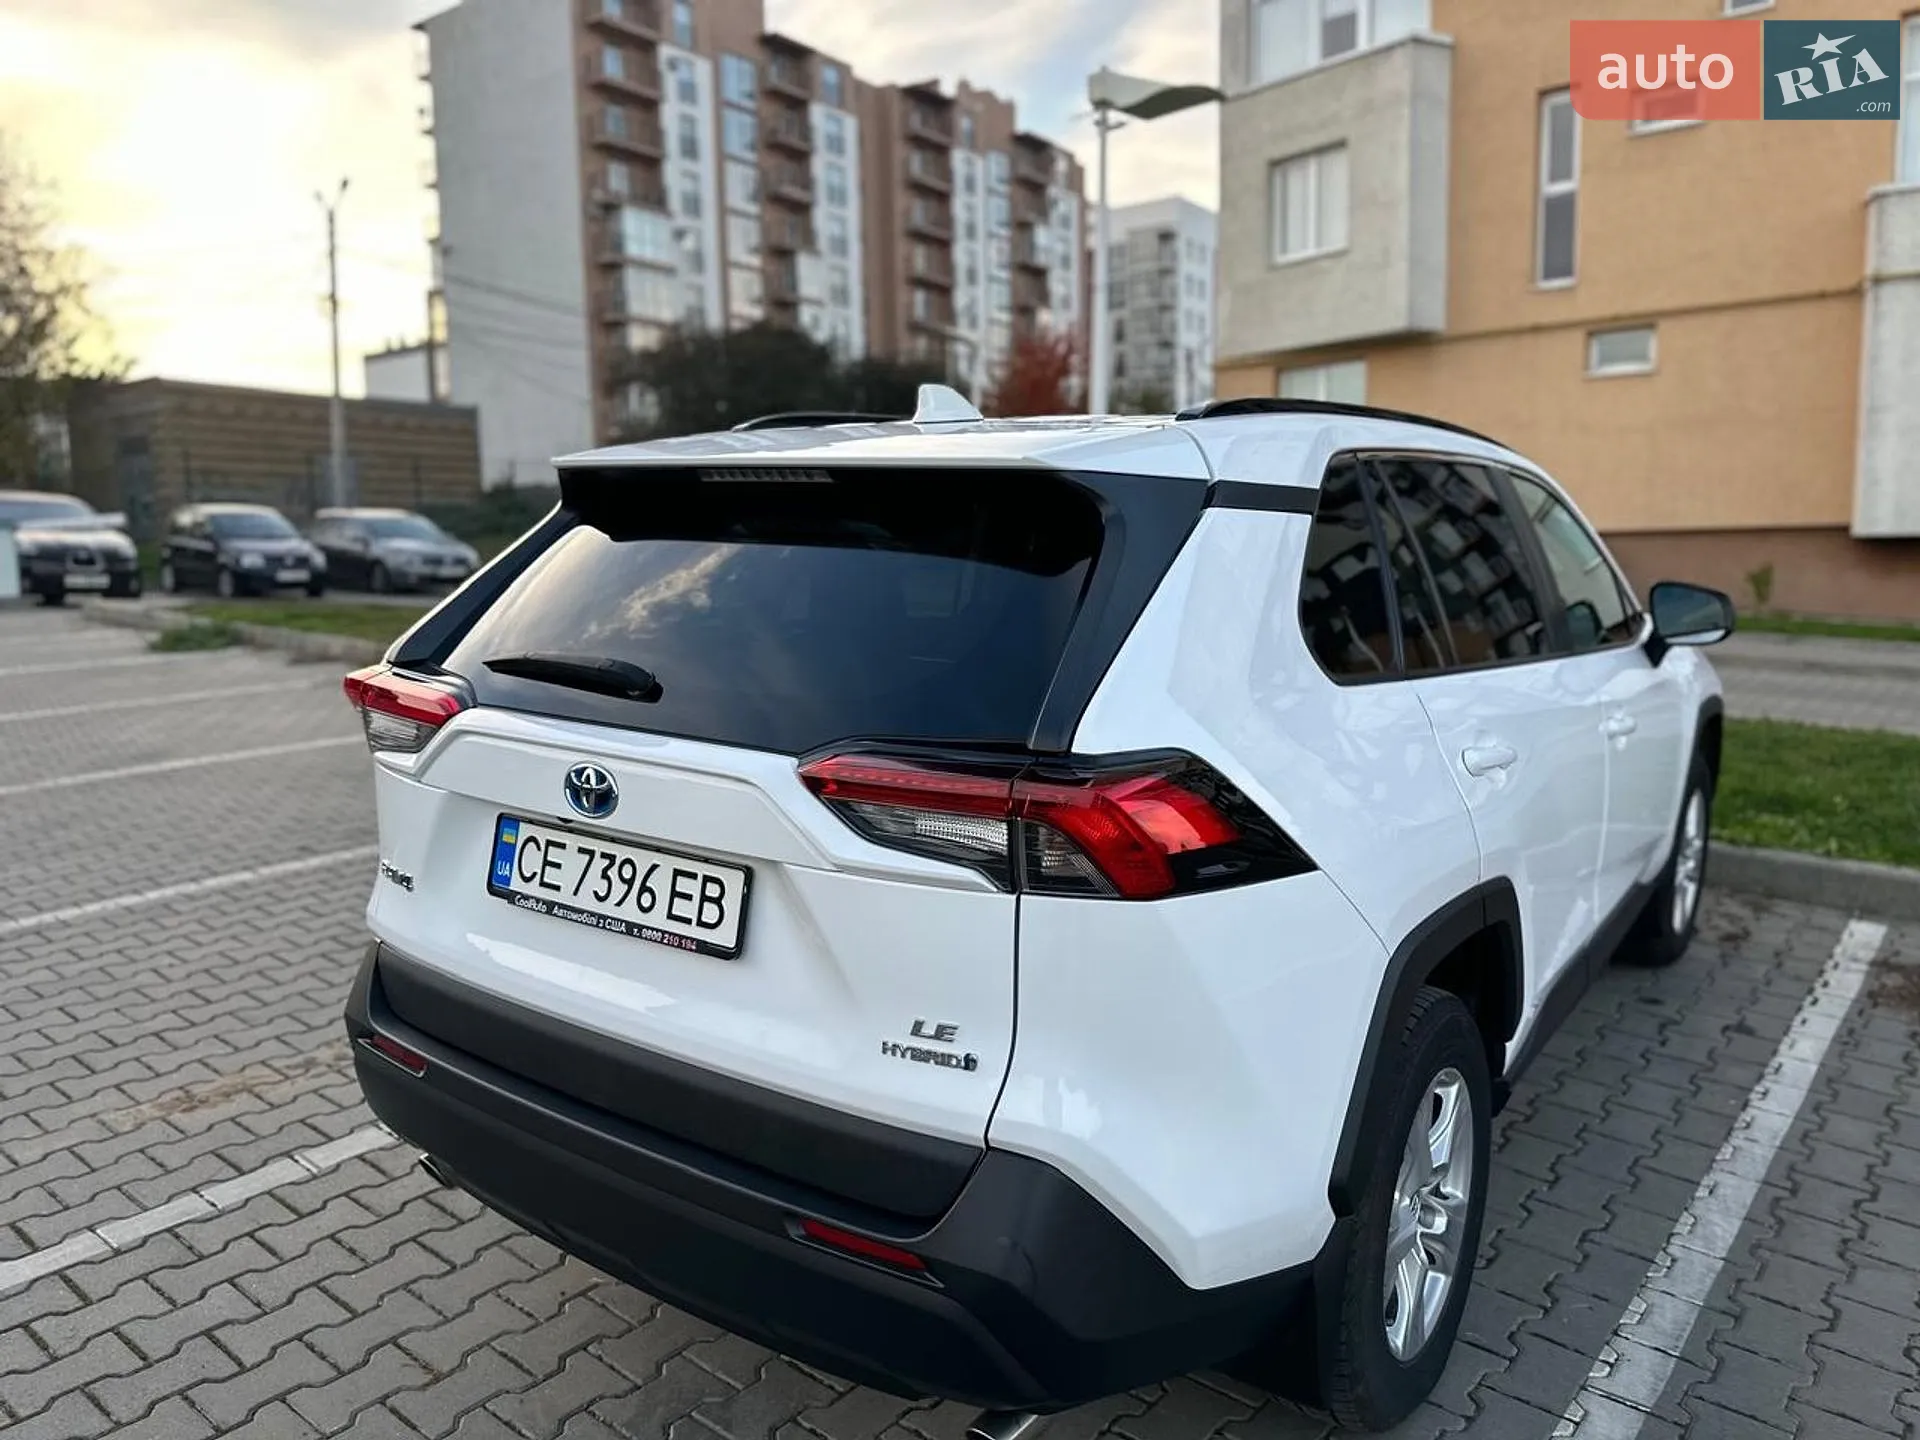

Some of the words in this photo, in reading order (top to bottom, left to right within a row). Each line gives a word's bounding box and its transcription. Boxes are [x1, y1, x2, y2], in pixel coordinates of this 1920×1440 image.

[497, 861, 511, 877] UA
[517, 835, 567, 892] CE
[573, 846, 661, 914] 7396
[666, 867, 726, 930] EB
[605, 919, 627, 933] США
[910, 1019, 960, 1042] LE
[882, 1041, 962, 1069] HYBRID
